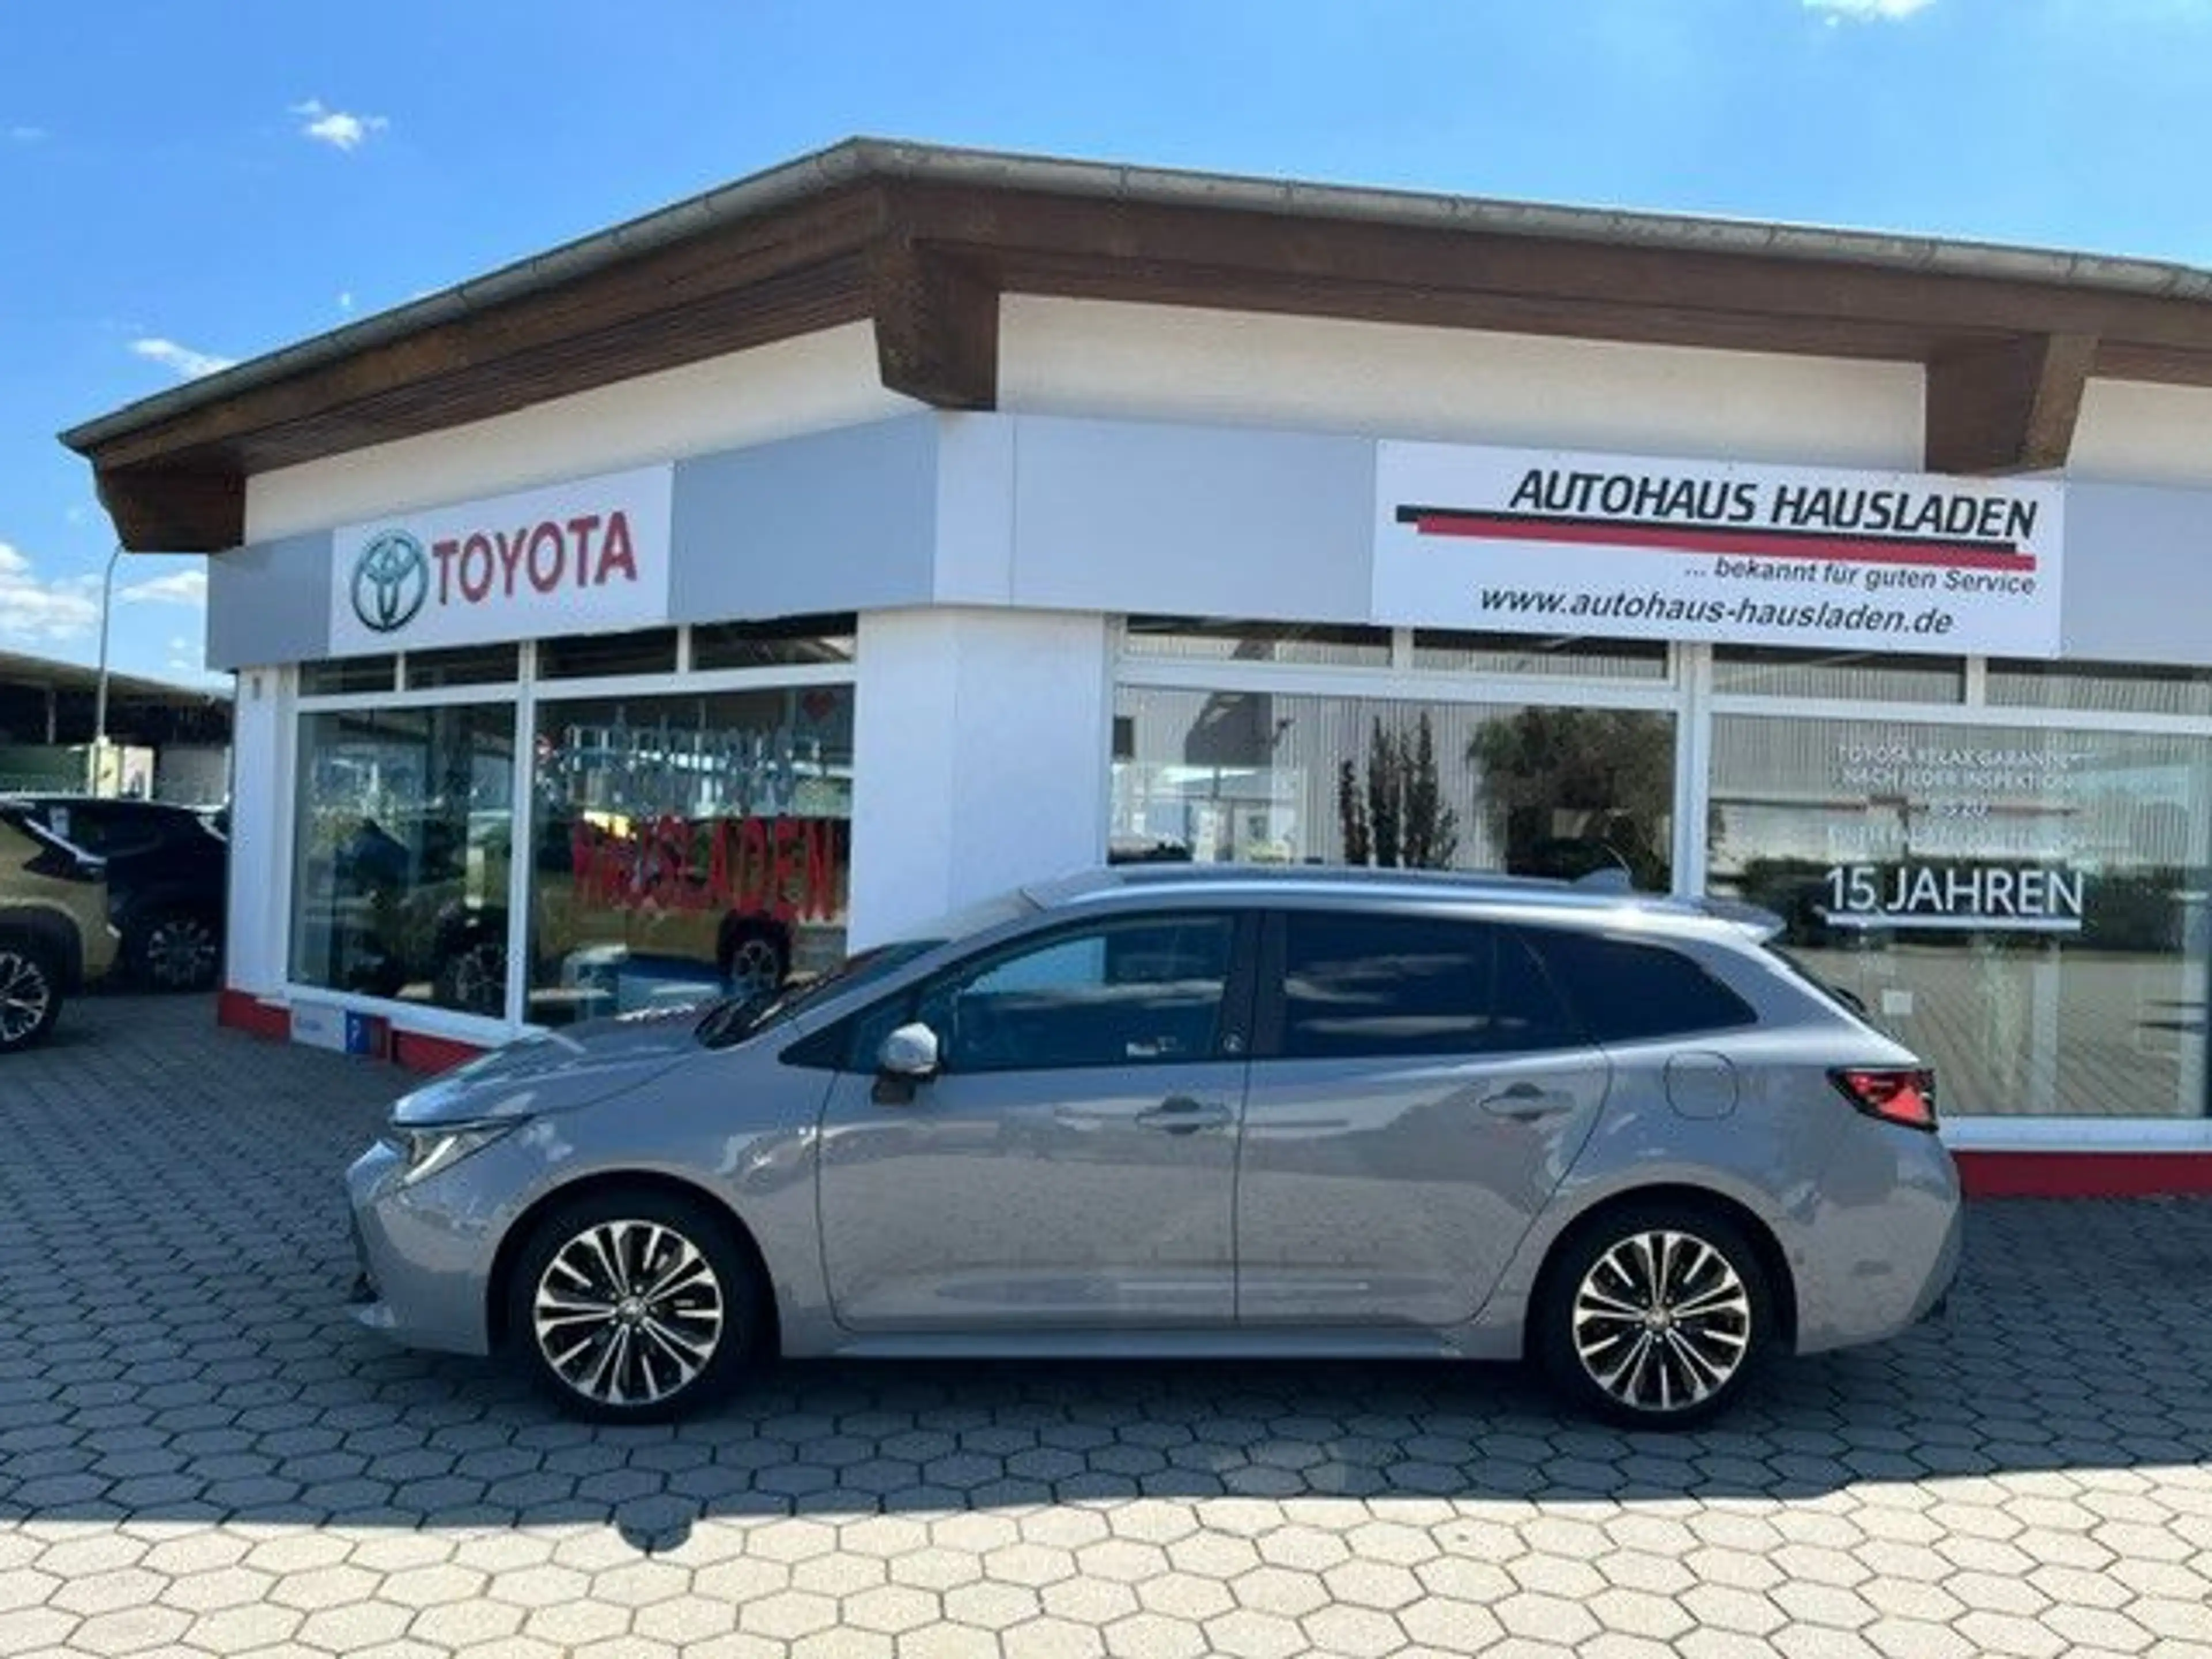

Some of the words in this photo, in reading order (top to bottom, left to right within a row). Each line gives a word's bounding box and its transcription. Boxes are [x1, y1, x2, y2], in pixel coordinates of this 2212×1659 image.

[1510, 469, 1757, 522] AUTOHAUS
[1768, 485, 2038, 539] HAUSLADEN
[432, 510, 637, 605] TOYOTA
[1714, 555, 1815, 582] bekannt
[1865, 569, 1937, 592] guten
[1944, 569, 2036, 594] Service
[1480, 588, 1955, 635] www.autohaus-hausladen.de
[1826, 866, 1877, 911] 15
[1887, 866, 2082, 915] JAHREN
